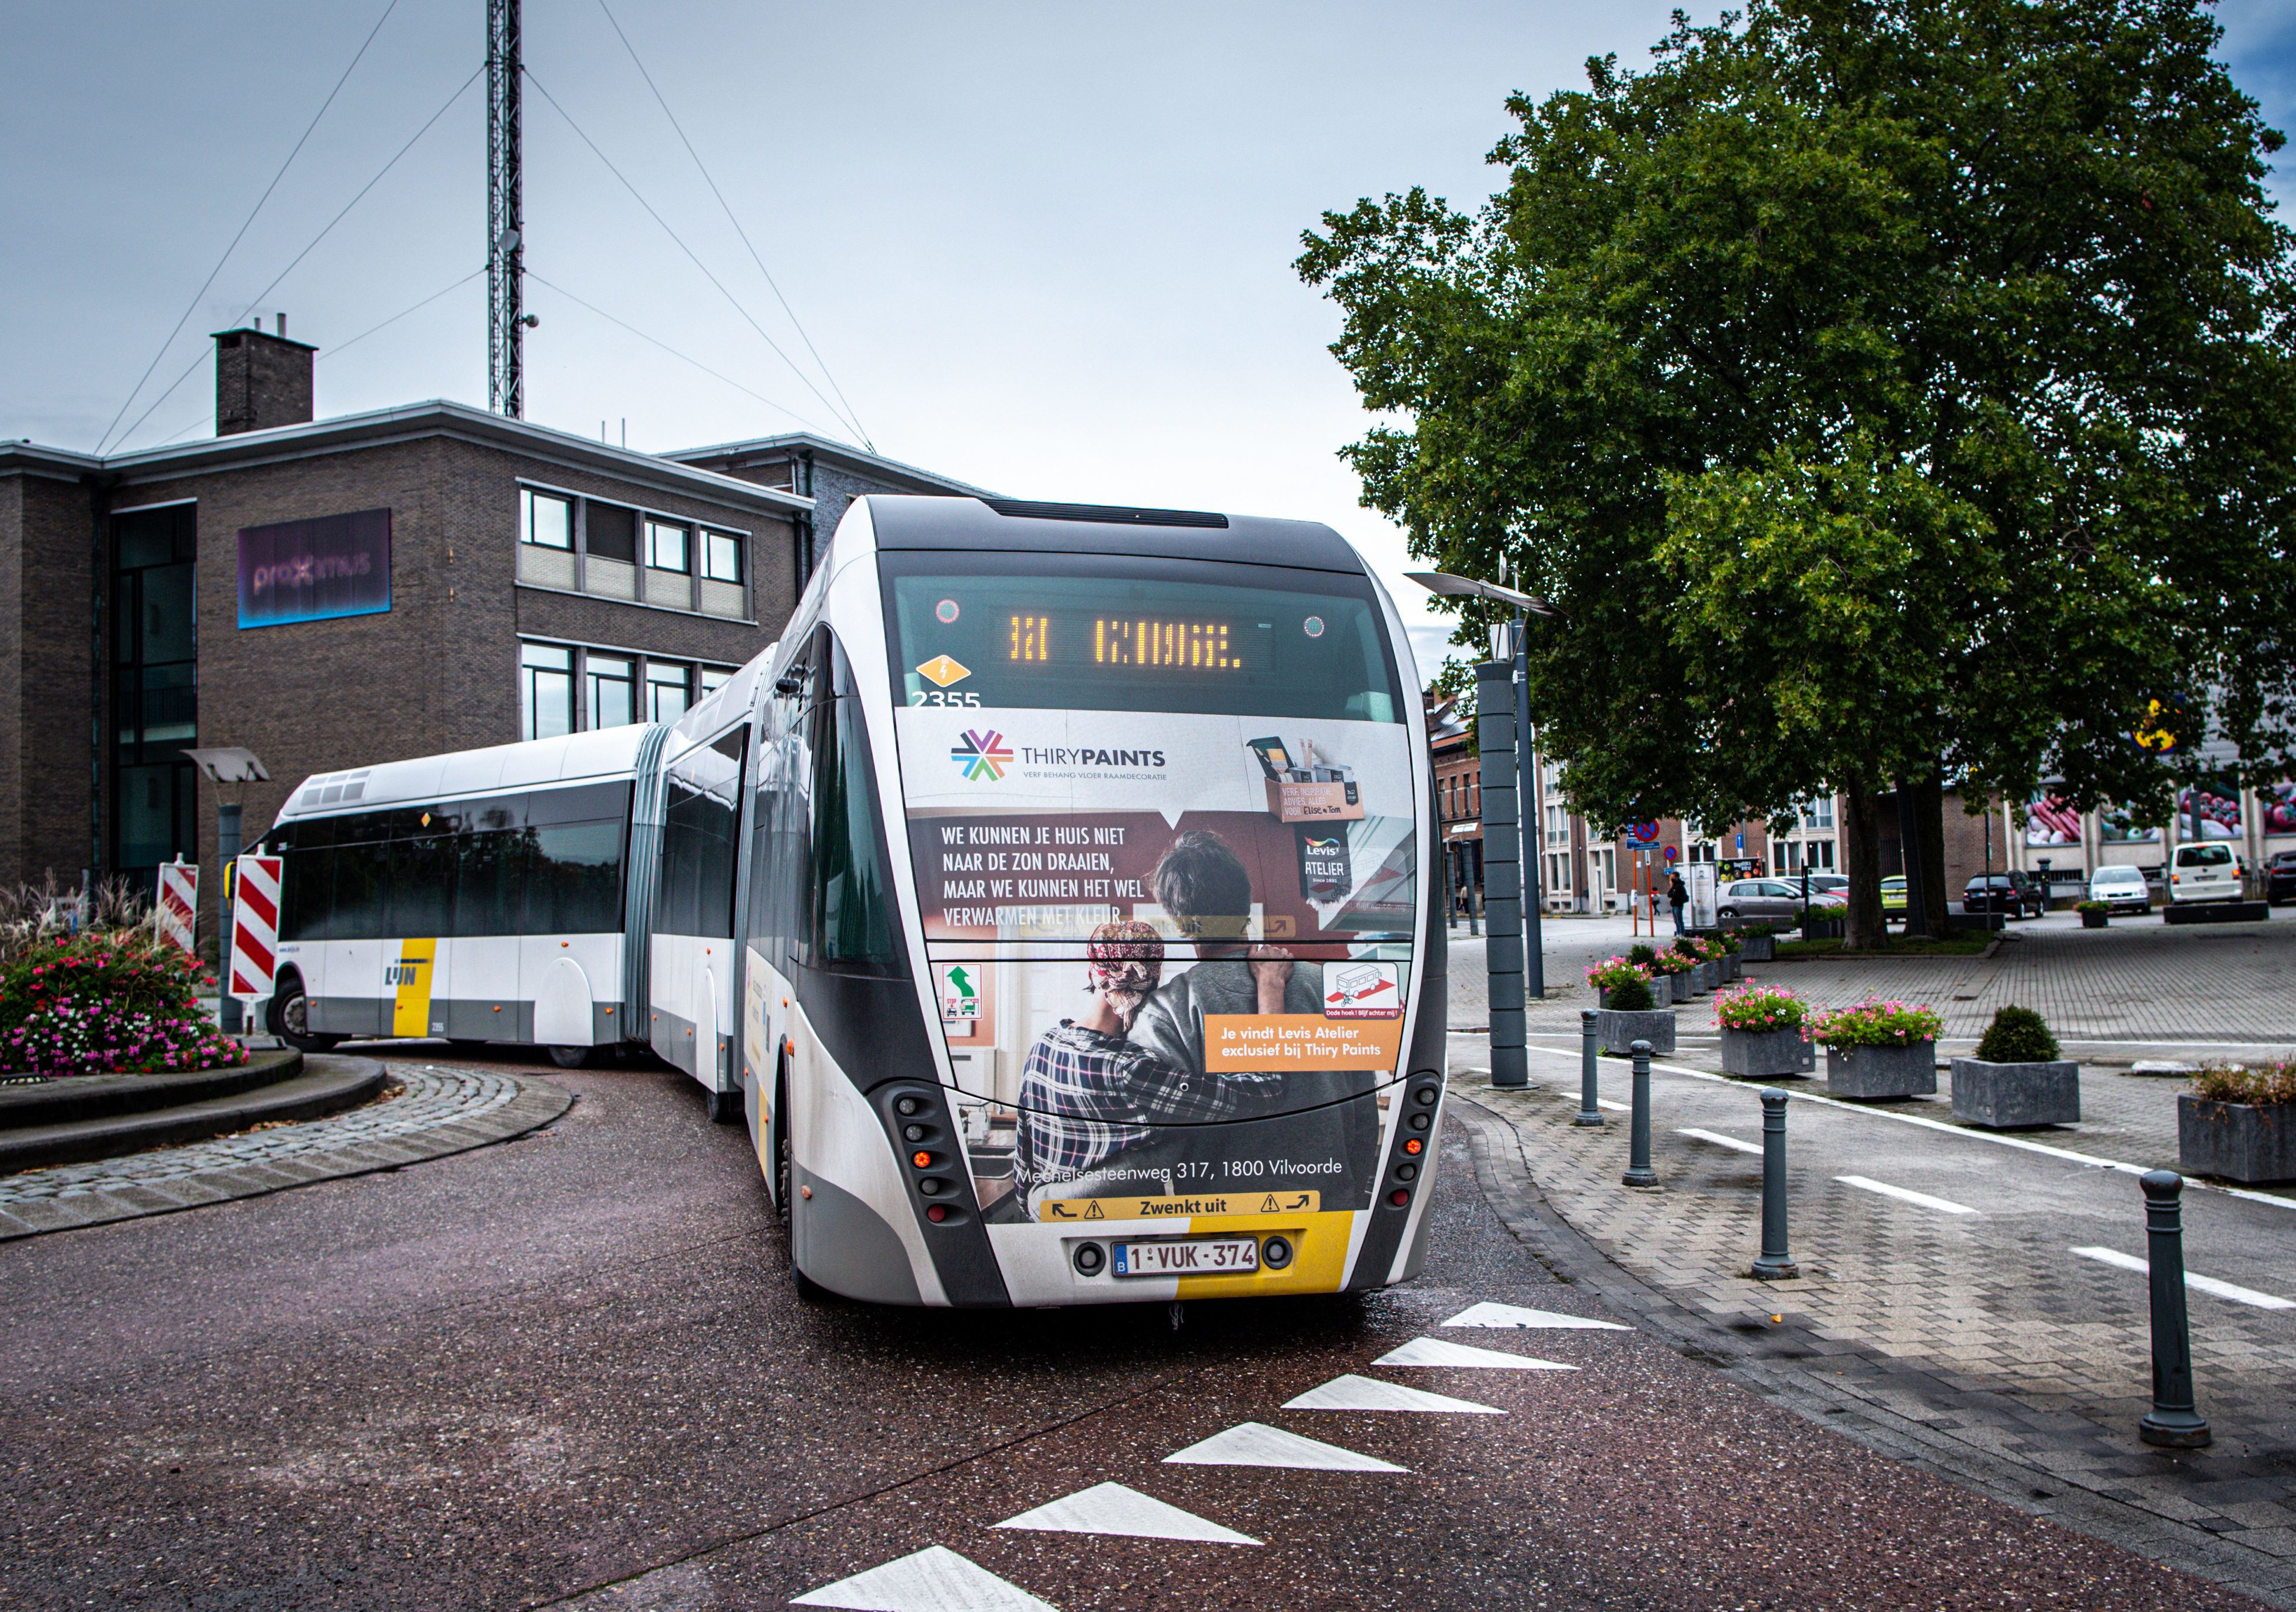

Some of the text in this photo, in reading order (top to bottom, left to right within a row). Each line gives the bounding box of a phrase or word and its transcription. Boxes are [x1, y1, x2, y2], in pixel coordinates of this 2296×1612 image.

[912, 691, 981, 711] 2355
[1022, 748, 1166, 767] THIRYPAINTS
[1285, 807, 1301, 815] VOOR
[1304, 805, 1323, 815] Elise
[1327, 805, 1341, 814] Tom
[942, 827, 1125, 844] WE KUNNEN JE HUIS NIET
[1307, 845, 1336, 855] Levis
[943, 853, 1114, 874] NAAR DE ZON DRAAIEN,
[1305, 861, 1344, 876] ATELIER
[943, 879, 1144, 898] MAAR WE KUNNEN HET WEL
[943, 907, 1036, 927] VERWARMEN
[1042, 907, 1071, 926] MET
[1221, 1026, 1359, 1040] Je vindt Levis Atelier
[1222, 1043, 1381, 1059] exclusief bij Thiry Paints
[1015, 1157, 1342, 1183] Mechelsesteenweg 317, 1800 Vilvoorde
[1140, 1198, 1227, 1215] Zwenkt uit
[1117, 1262, 1125, 1272] B
